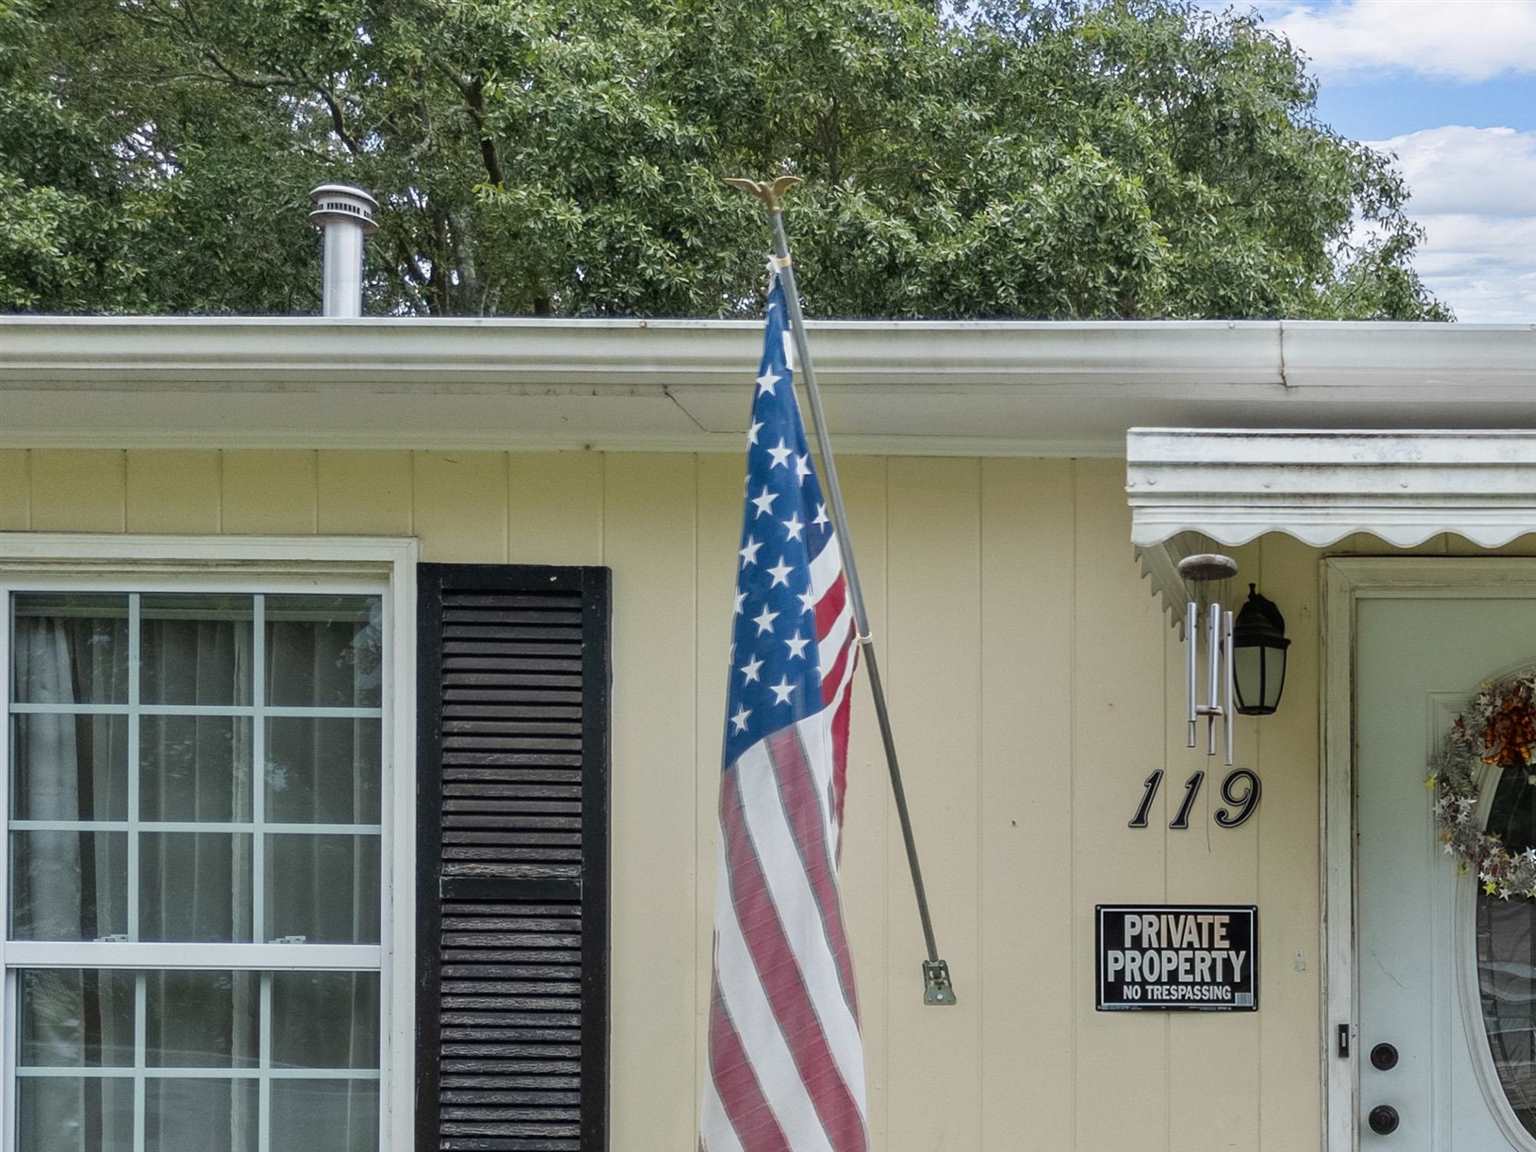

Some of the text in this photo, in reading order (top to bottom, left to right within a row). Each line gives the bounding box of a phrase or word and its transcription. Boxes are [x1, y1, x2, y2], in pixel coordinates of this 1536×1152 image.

[1128, 768, 1262, 829] 119
[1124, 914, 1230, 948] PRIVATE
[1107, 949, 1247, 983] PROPERTY
[1123, 985, 1232, 1000] NO TRESPASSING
